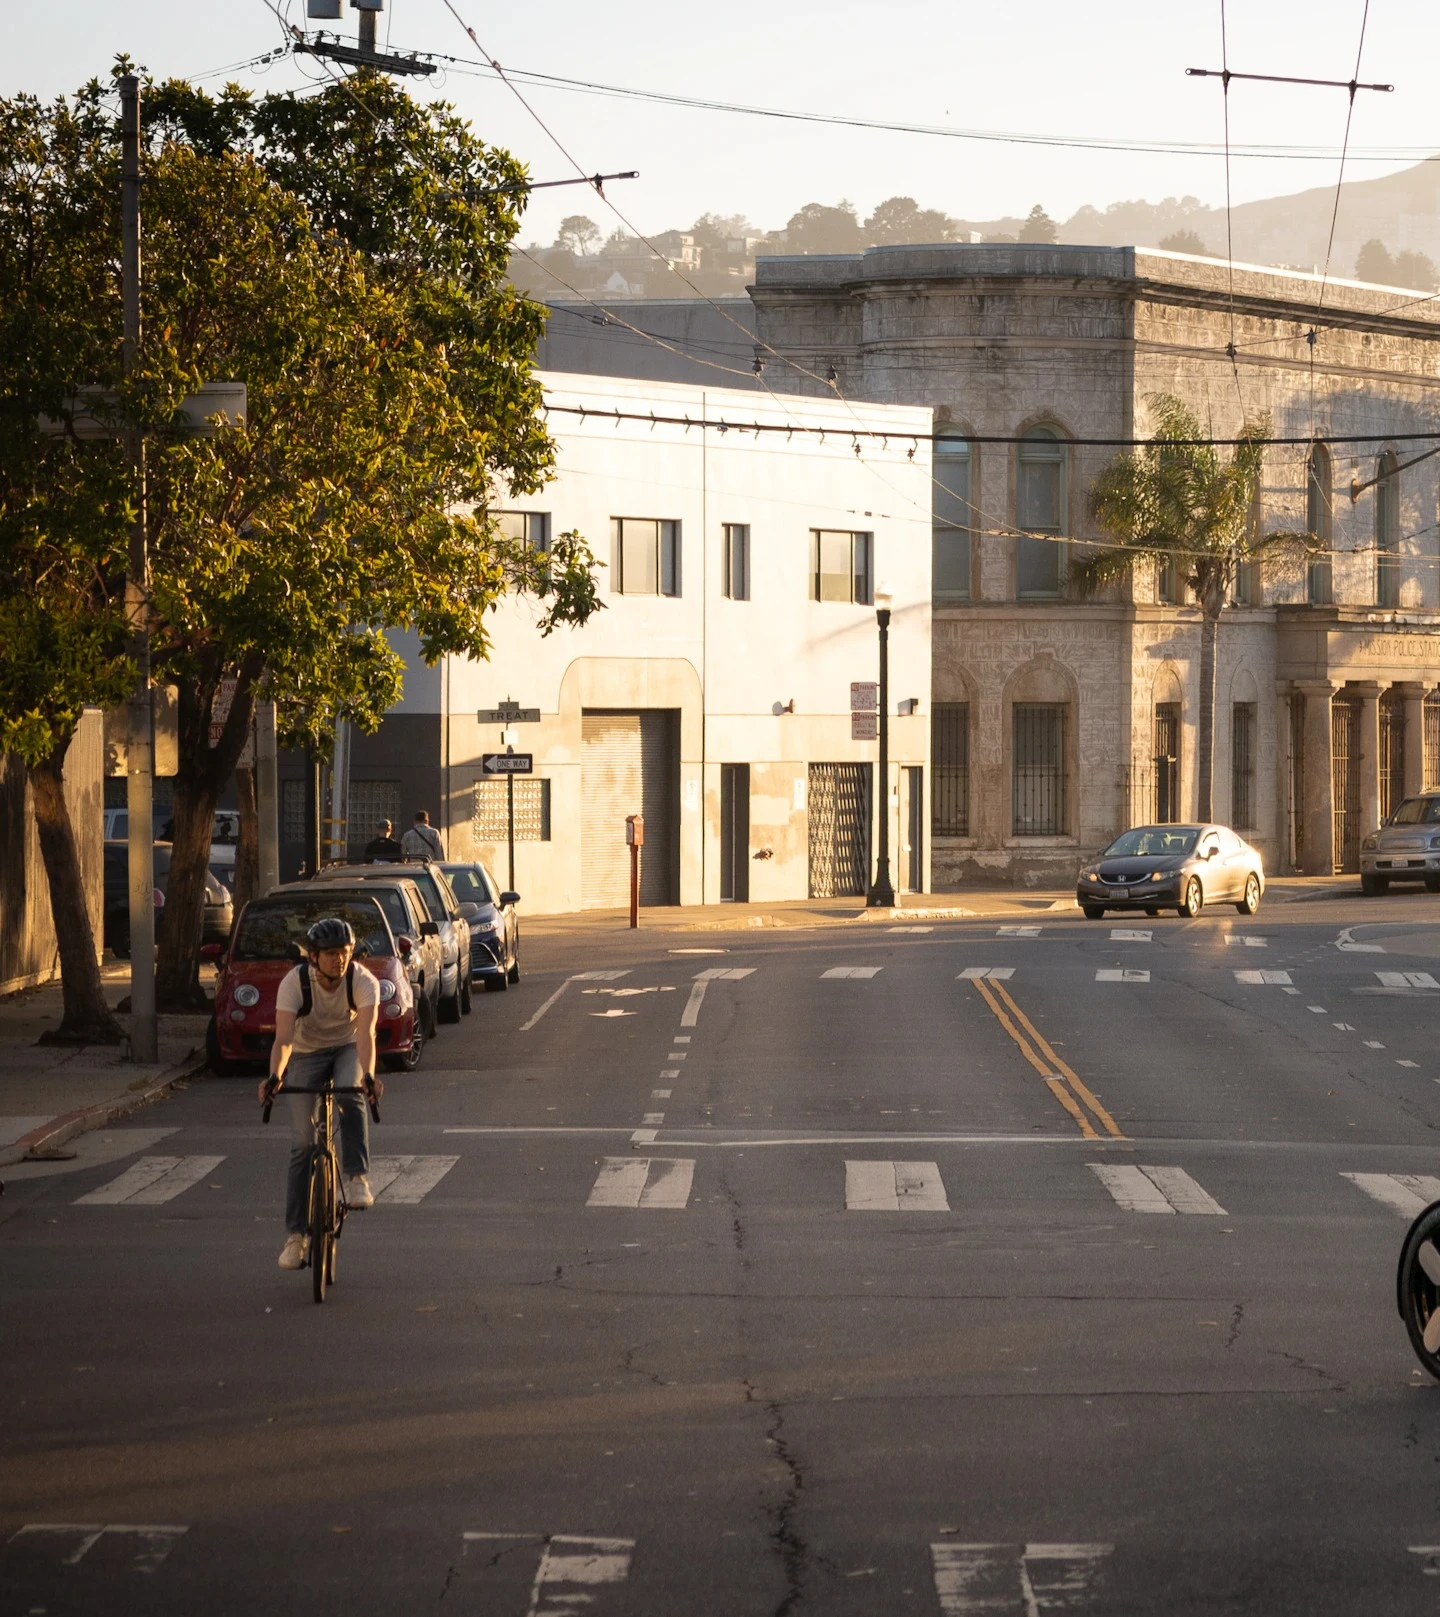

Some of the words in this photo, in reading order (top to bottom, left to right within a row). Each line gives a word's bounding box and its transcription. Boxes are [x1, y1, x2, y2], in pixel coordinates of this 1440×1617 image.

[1364, 639, 1391, 656] MISSION
[1393, 640, 1417, 657] POLICE
[489, 711, 529, 721] TREAT
[496, 760, 511, 768] ONE
[513, 760, 527, 768] WAY
